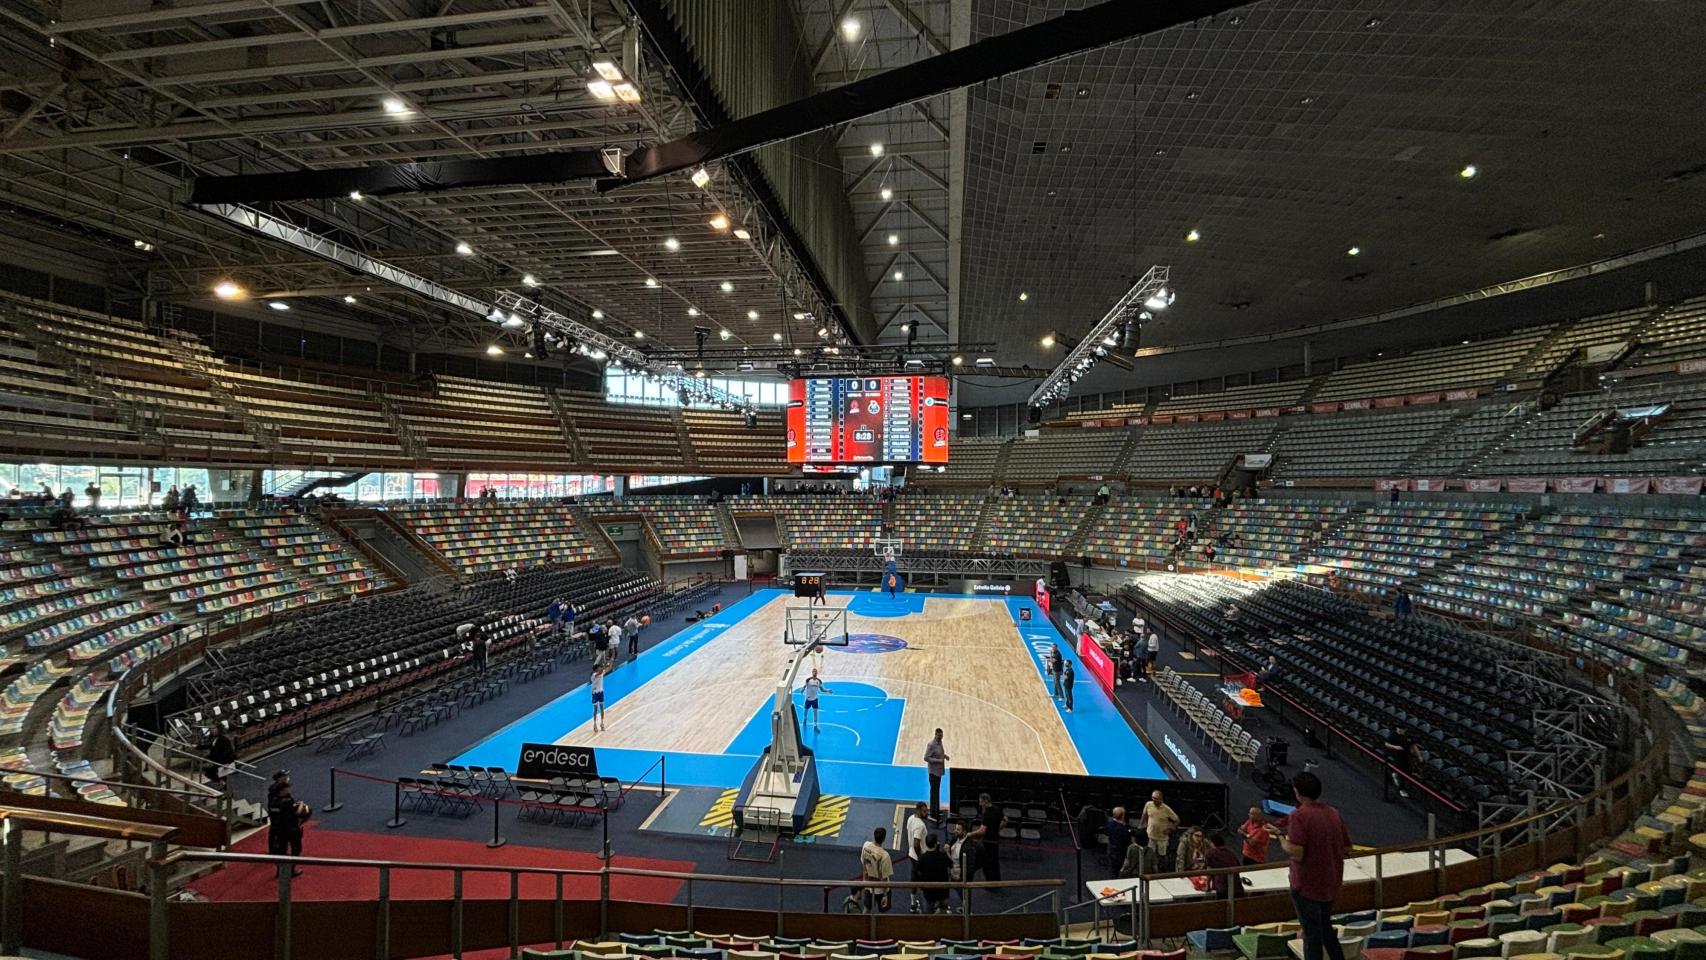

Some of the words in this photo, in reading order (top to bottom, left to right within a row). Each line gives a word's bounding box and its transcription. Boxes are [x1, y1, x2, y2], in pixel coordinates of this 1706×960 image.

[851, 380, 858, 390] 0
[869, 380, 877, 390] 0
[855, 432, 872, 440] 8:28
[523, 747, 590, 767] endesa
